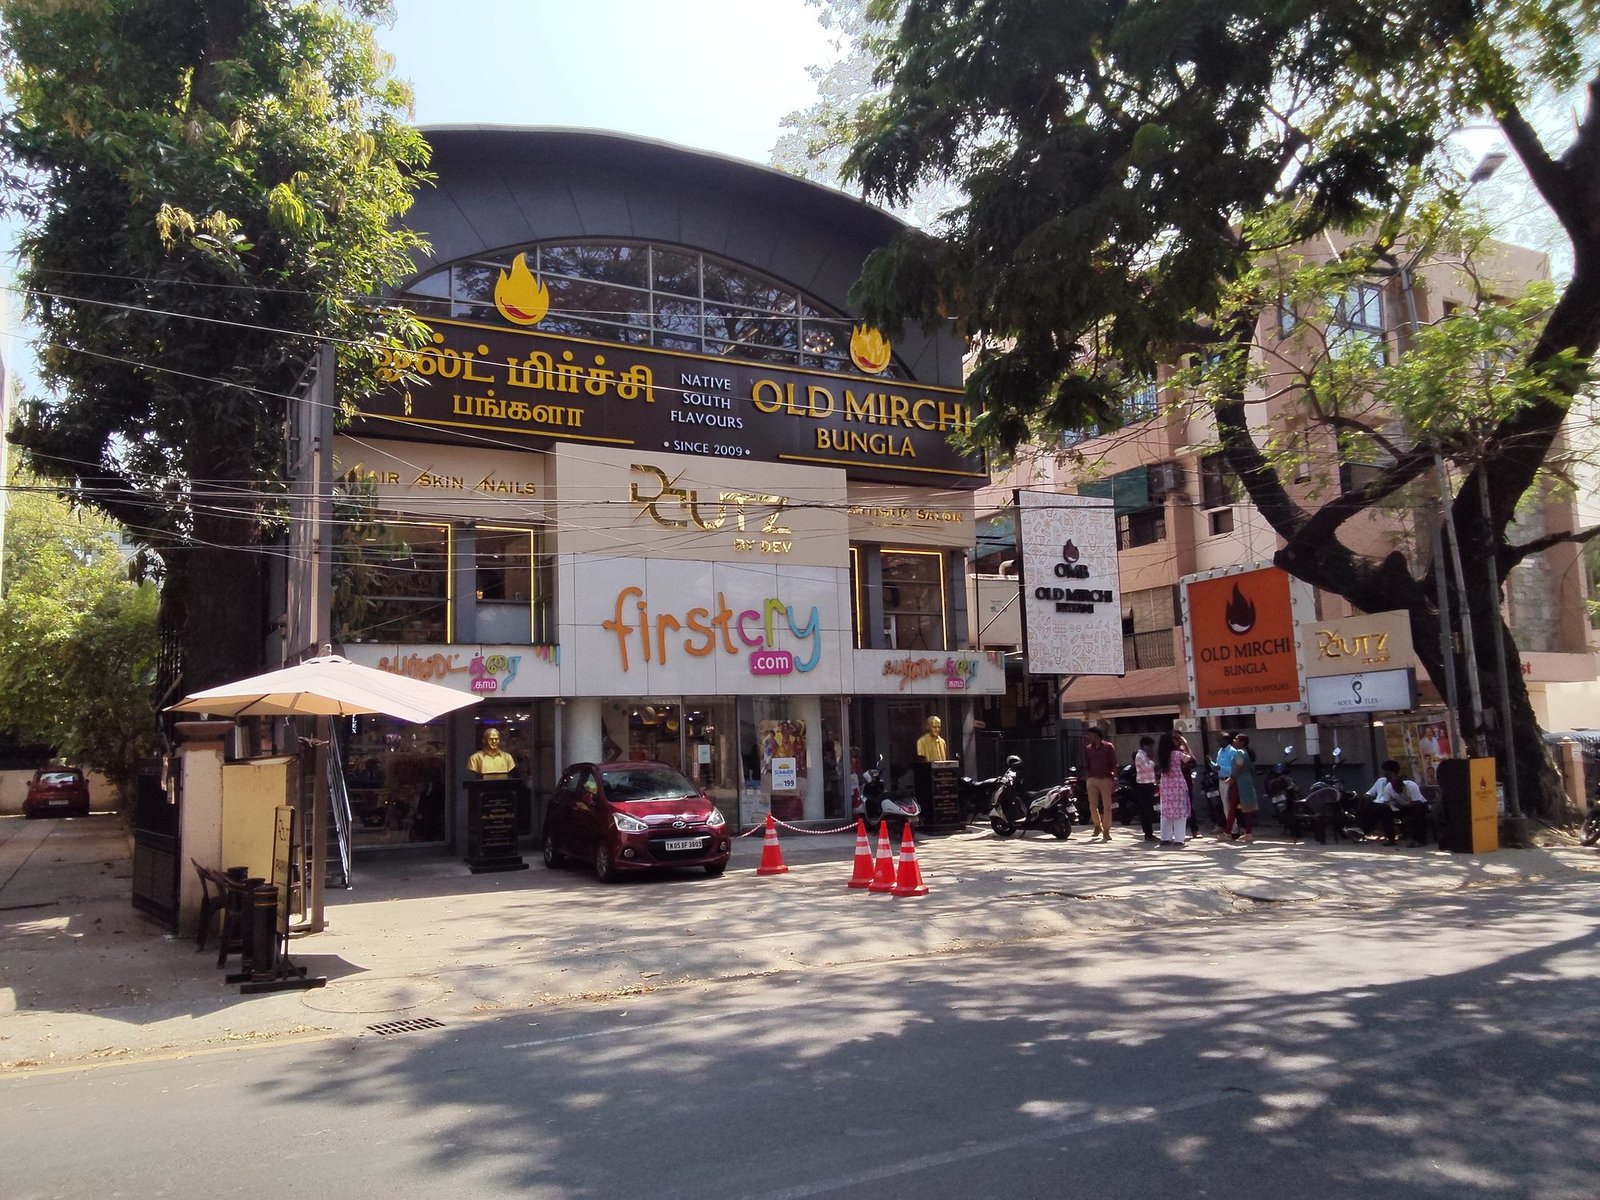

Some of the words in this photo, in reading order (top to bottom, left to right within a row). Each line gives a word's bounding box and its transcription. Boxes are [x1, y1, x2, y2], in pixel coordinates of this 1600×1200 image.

[681, 373, 731, 390] NATIVE
[453, 389, 584, 427] பங்களா
[683, 392, 731, 409] SOUTH
[752, 379, 835, 419] OLD
[846, 390, 972, 435] MIRCHI
[670, 410, 743, 429] FLAVOURS
[673, 440, 709, 454] SINCE
[714, 444, 743, 457] 2009
[816, 427, 916, 457] BUNGLA
[420, 473, 464, 489] SKIN
[484, 477, 536, 495] NAILS
[917, 509, 963, 523] SALON
[734, 538, 756, 551] BY
[761, 540, 792, 553] DEV
[1035, 587, 1064, 601] OLD
[602, 586, 821, 673] firstcry
[1201, 645, 1230, 662] OLD
[1234, 637, 1290, 659] MIRCHI
[753, 655, 789, 670] .com
[1223, 662, 1267, 677] BUNGLA
